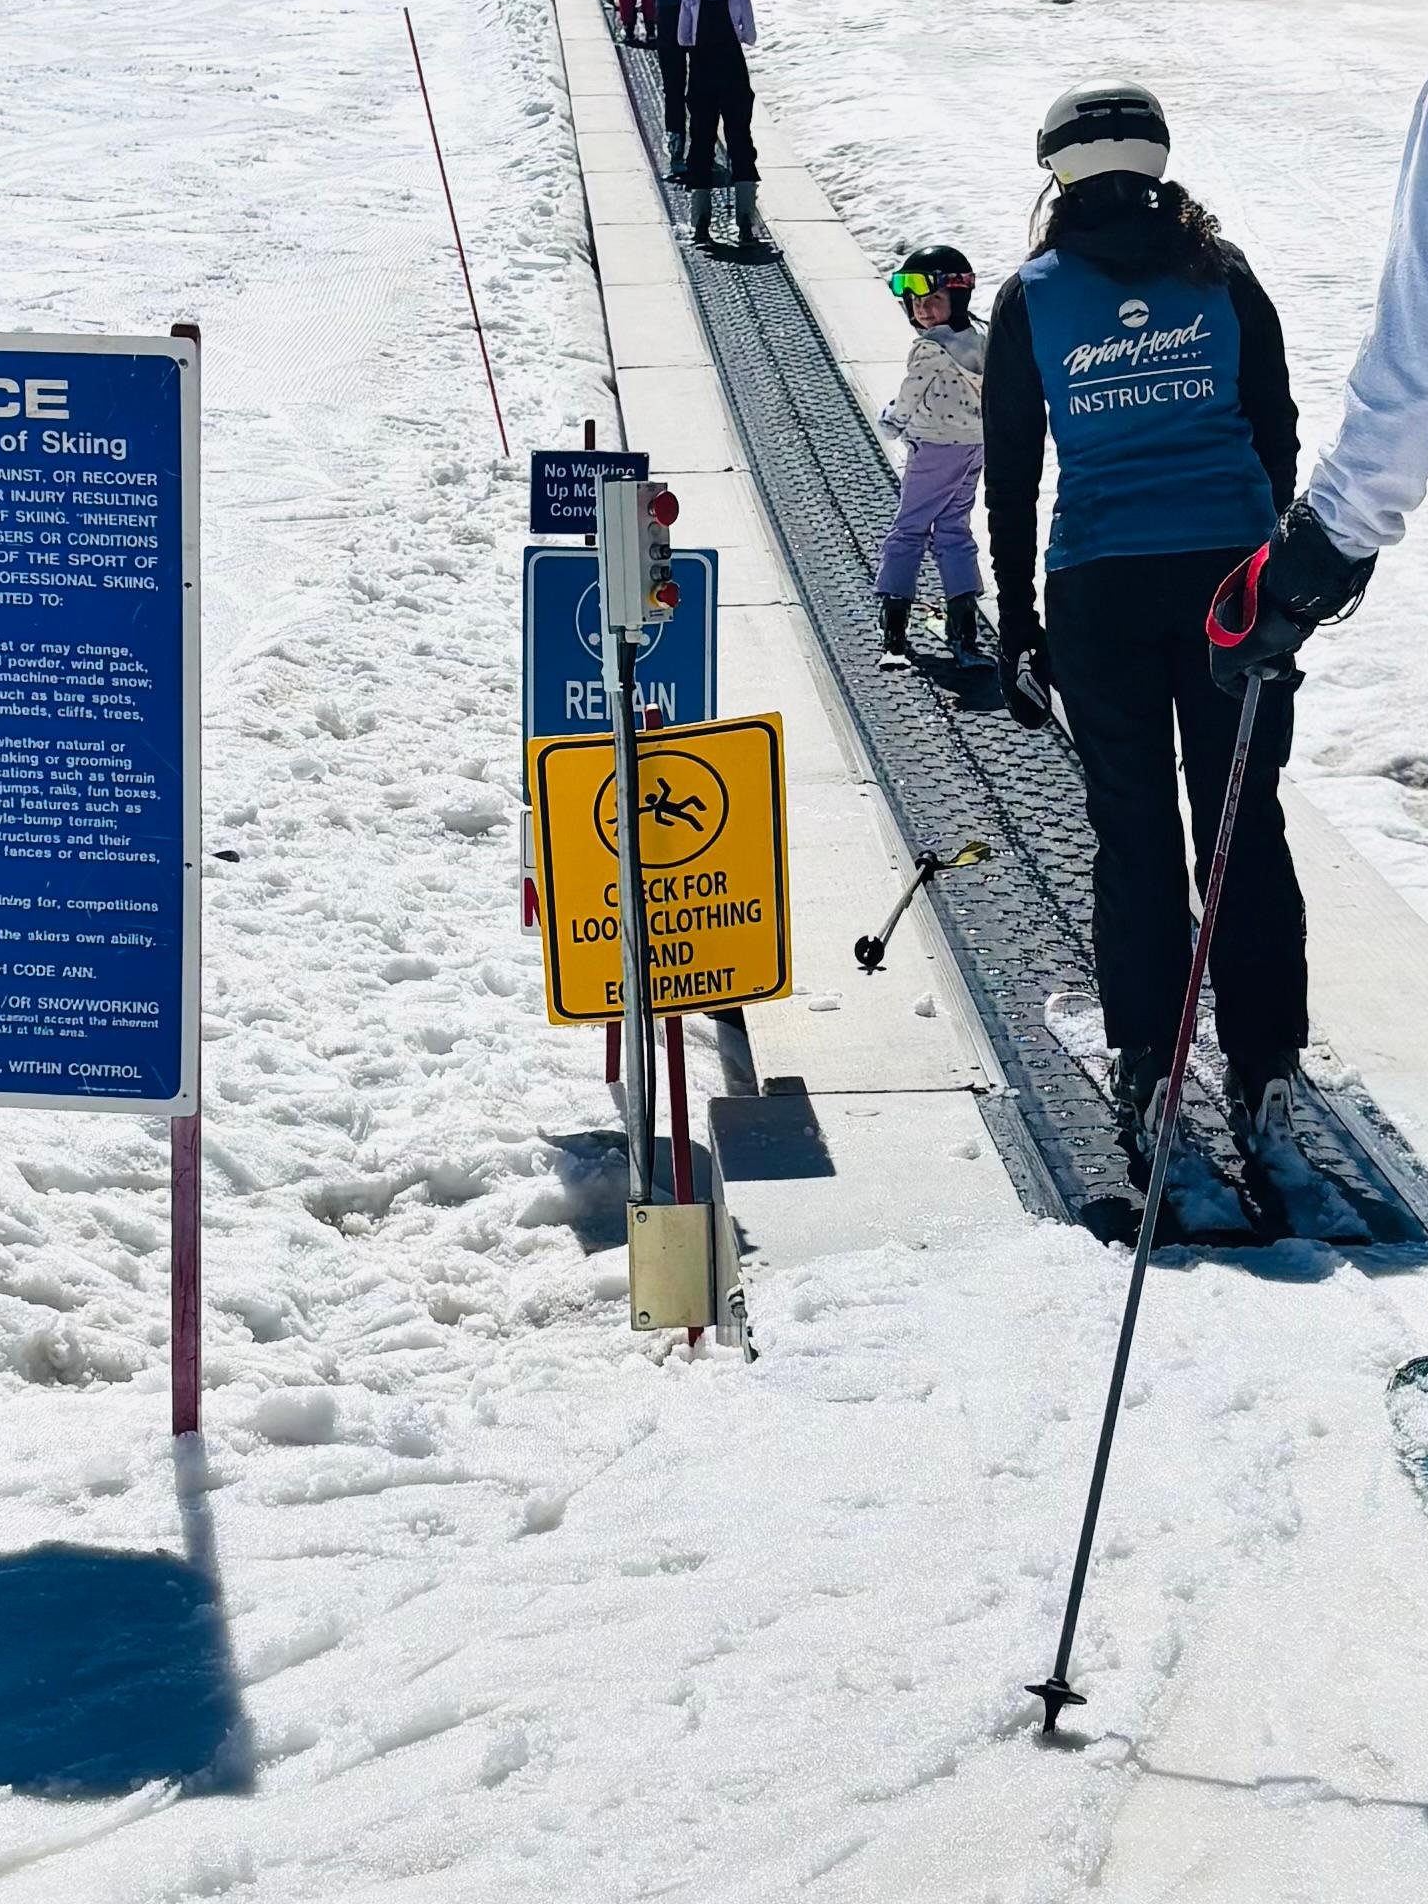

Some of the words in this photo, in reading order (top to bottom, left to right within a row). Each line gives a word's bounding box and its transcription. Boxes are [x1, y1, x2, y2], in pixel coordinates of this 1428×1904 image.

[1069, 378, 1215, 415] INSTRUCTOR
[0, 430, 28, 452] of
[42, 430, 126, 461] Skiing
[53, 470, 76, 483] OR
[83, 471, 157, 486] RECOVER
[545, 464, 566, 477] No
[11, 489, 65, 503] INJURY
[72, 491, 158, 507] RESULTING
[547, 484, 568, 500] Up
[551, 503, 595, 516] Conv
[40, 531, 61, 545] OR
[67, 532, 158, 549] CONDITIONS
[26, 551, 60, 566] THE
[68, 553, 127, 567] SPORT
[134, 556, 158, 569] OF
[566, 680, 676, 721] REAIN
[604, 877, 679, 908] CECK
[684, 871, 728, 900] FOR
[650, 899, 762, 936] CLOTHING
[648, 941, 694, 969] AND
[13, 963, 55, 977] CODE
[605, 968, 736, 1005] EIPMENT
[8, 1060, 62, 1075] WITHIN
[68, 1062, 142, 1079] CONTROL
